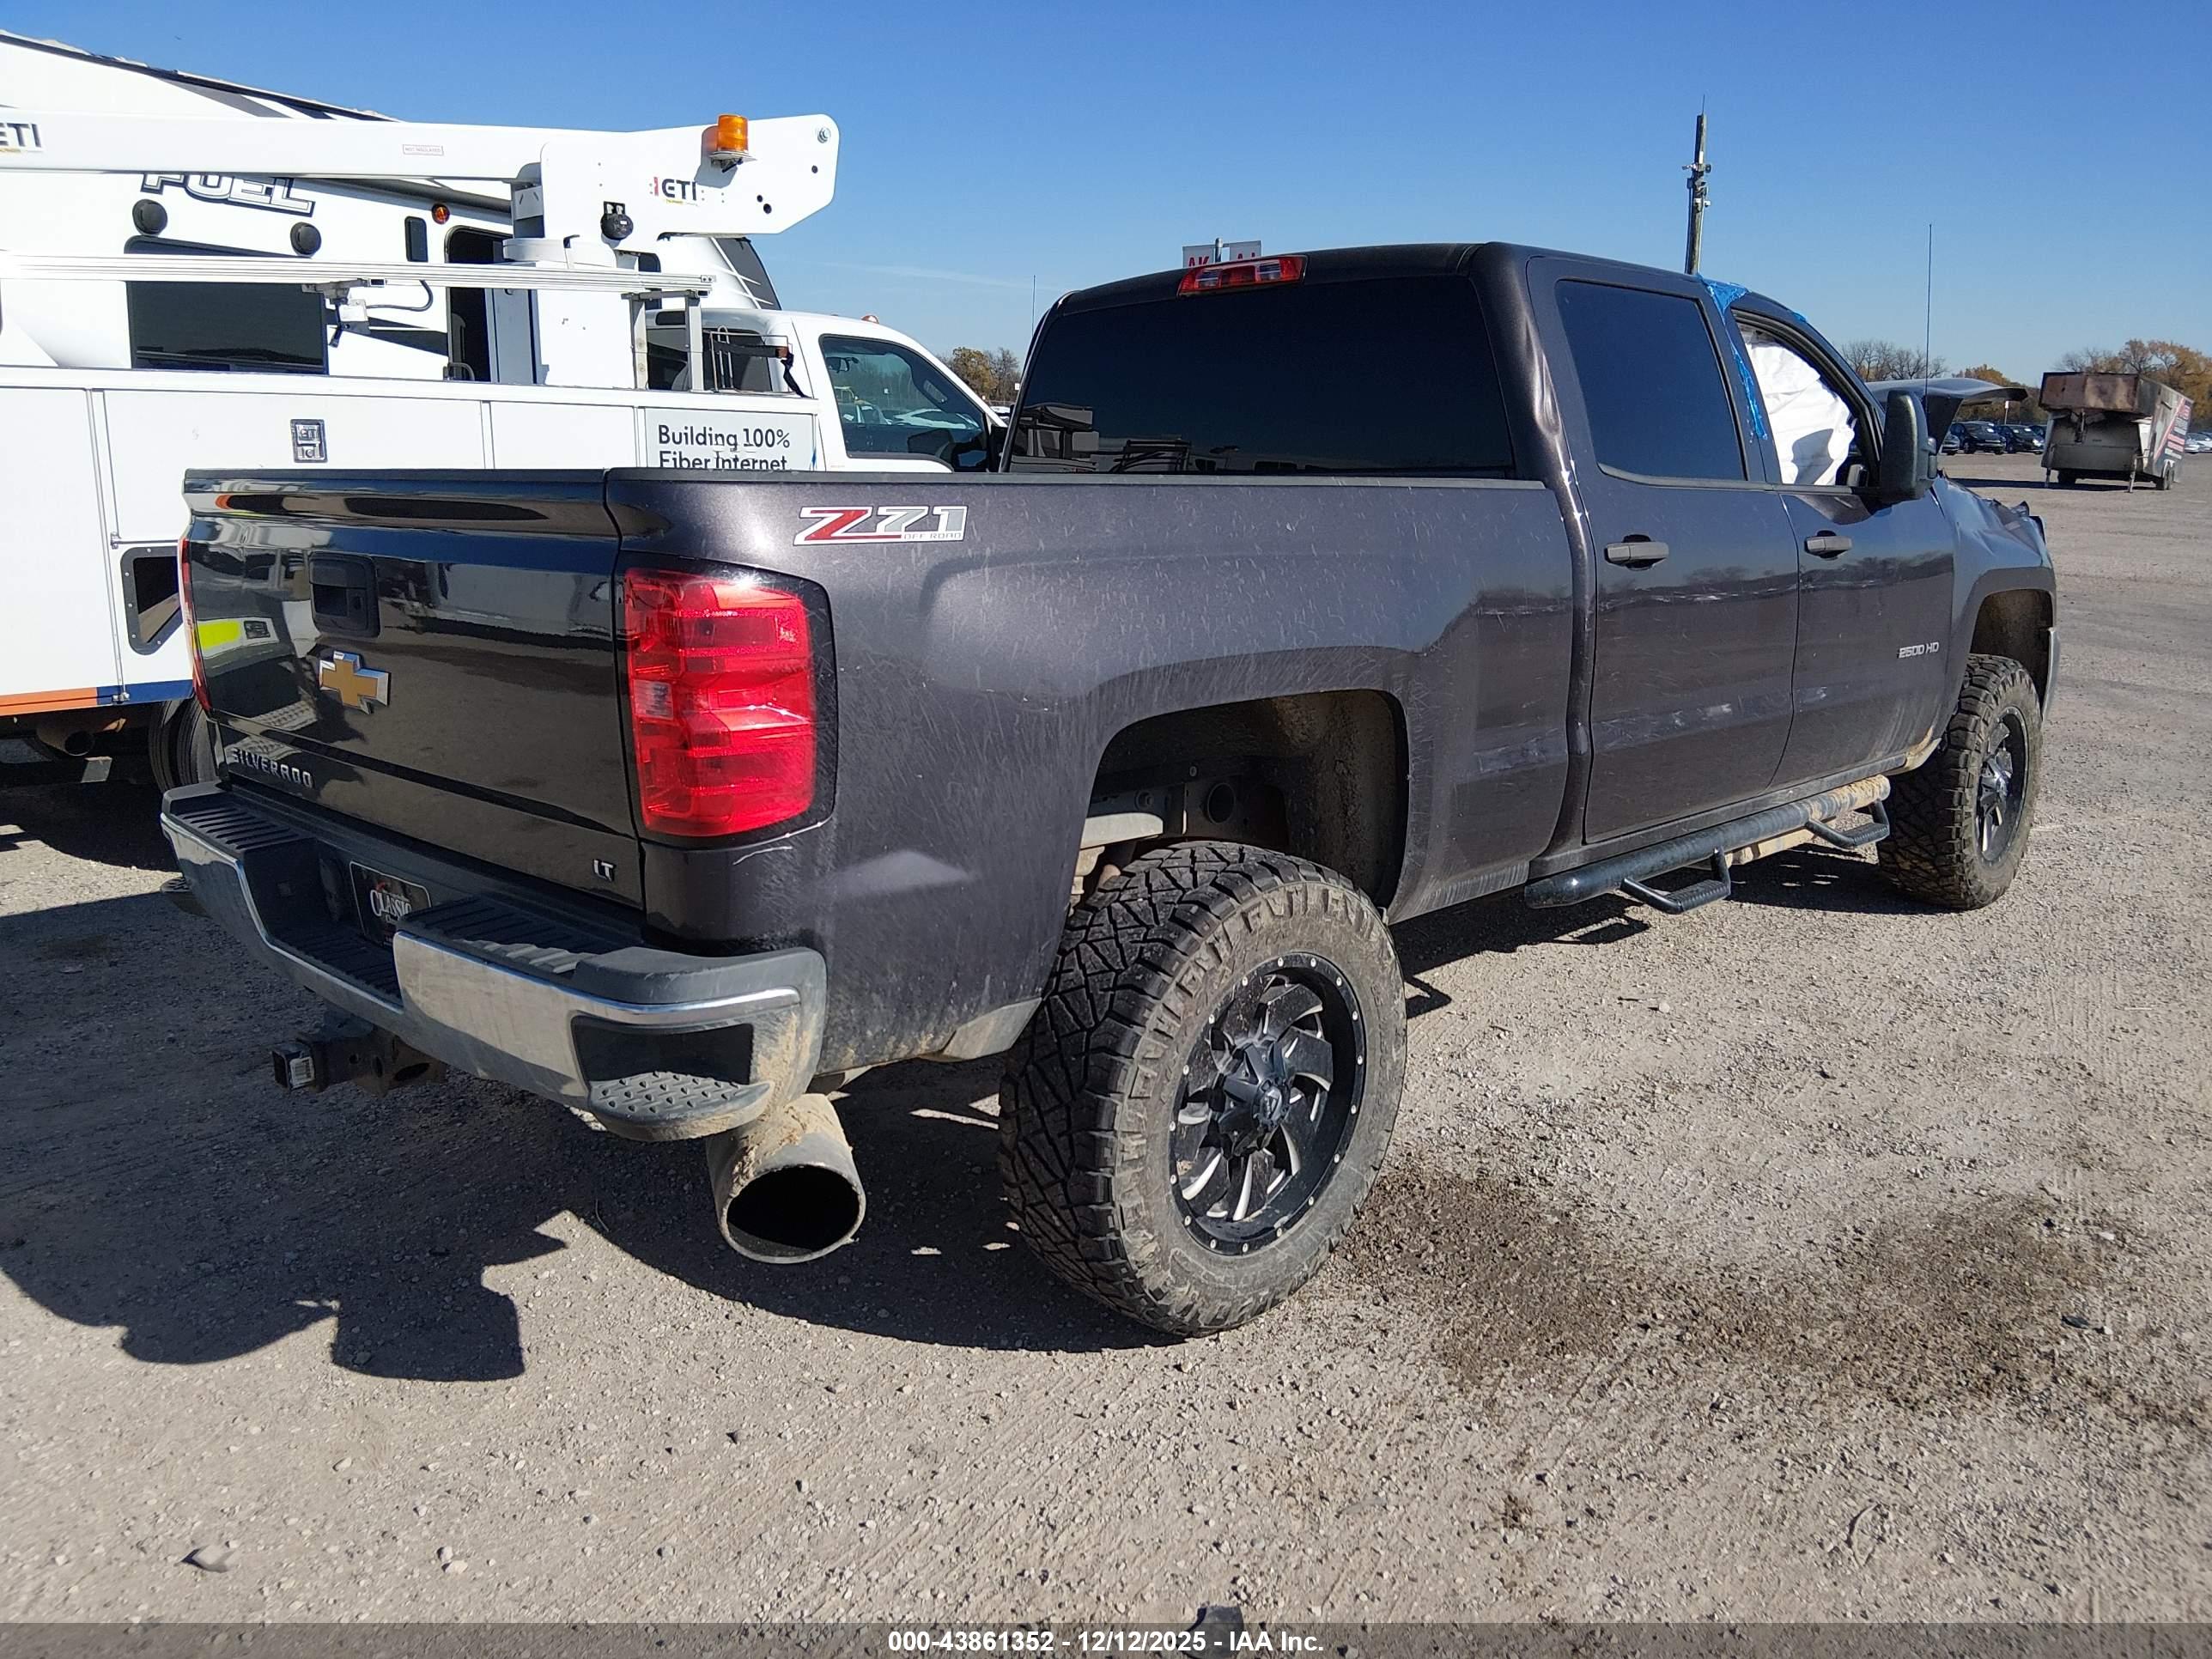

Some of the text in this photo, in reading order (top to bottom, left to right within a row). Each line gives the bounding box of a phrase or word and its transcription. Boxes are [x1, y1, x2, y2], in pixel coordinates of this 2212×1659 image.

[661, 178, 697, 201] ETI
[659, 424, 790, 452] Building 100%
[659, 450, 787, 471] Fiber Internet
[793, 505, 969, 546] Z71
[1899, 641, 1940, 659] 2500 HD
[230, 746, 313, 788] SILVERADO
[593, 859, 614, 883] LT
